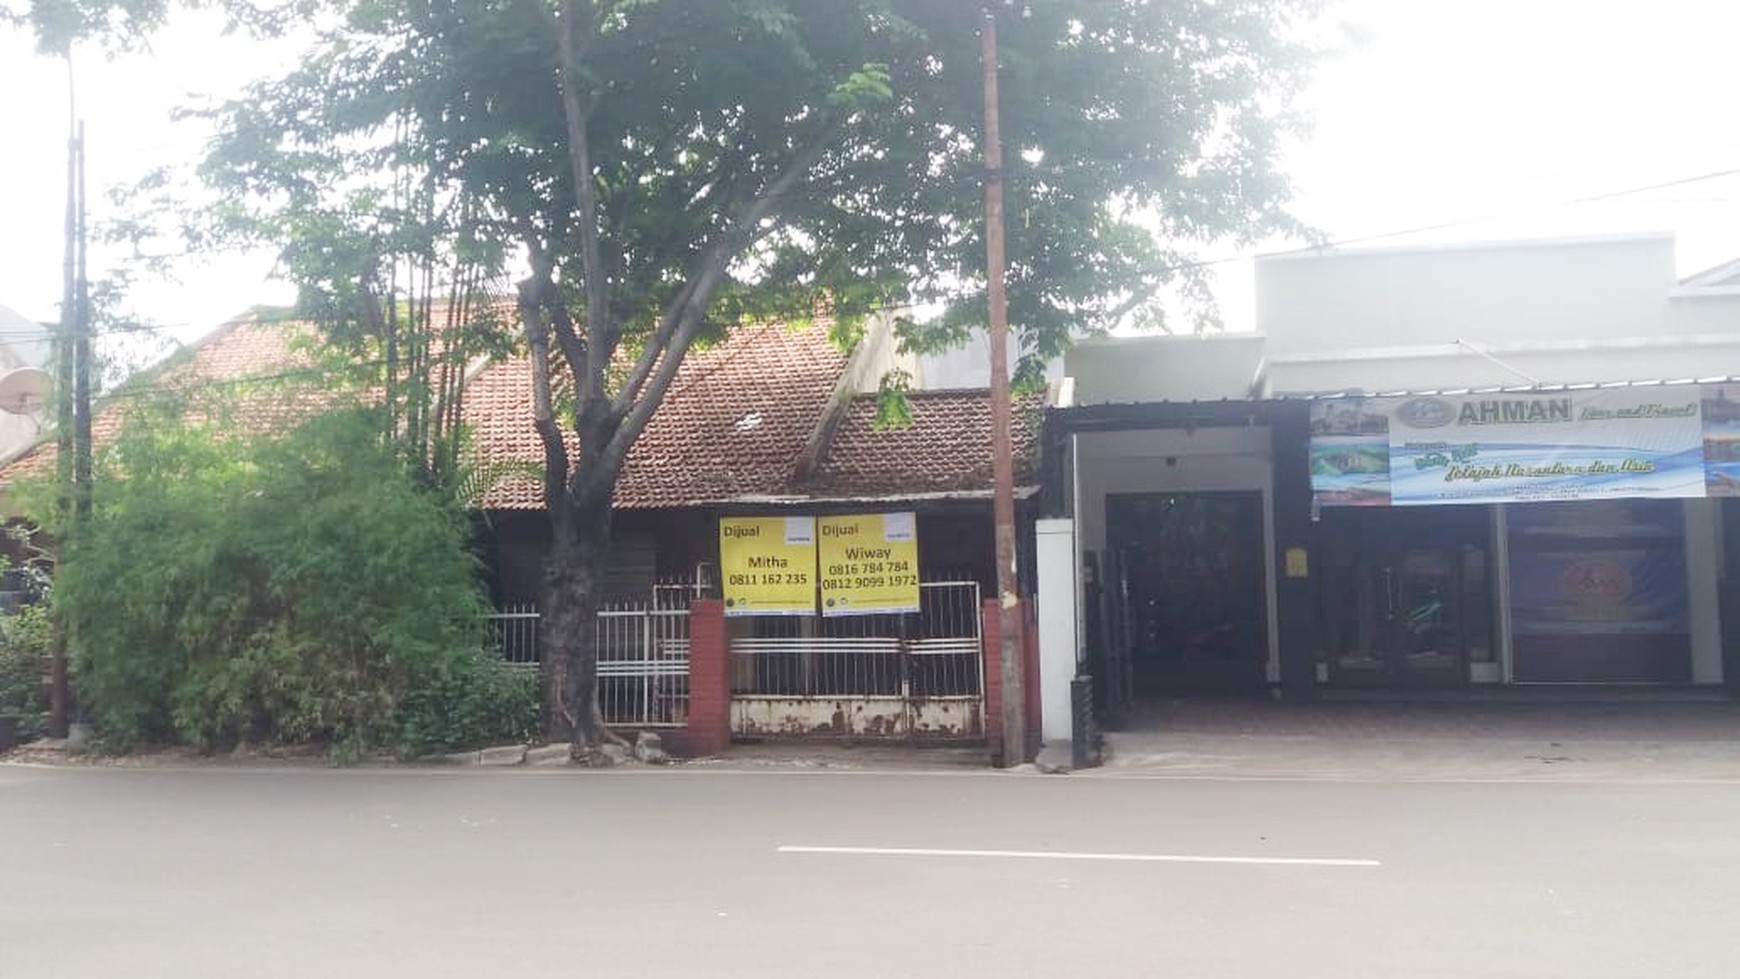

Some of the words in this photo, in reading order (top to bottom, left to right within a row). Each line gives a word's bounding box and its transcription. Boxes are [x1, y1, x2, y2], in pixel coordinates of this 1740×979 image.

[1457, 399, 1572, 426] AHMAN
[724, 525, 760, 539] Dijual
[822, 523, 859, 537] Dijual
[845, 547, 891, 560] Wiway
[748, 555, 788, 568] Mitha
[829, 564, 858, 575] 0816
[862, 562, 883, 574] 784
[886, 560, 908, 572] 784
[729, 574, 756, 585] 0811
[762, 574, 782, 585] 162
[785, 574, 807, 584] 235
[822, 578, 851, 590] 0812
[855, 577, 884, 589] 9099
[888, 574, 917, 587] 1972
